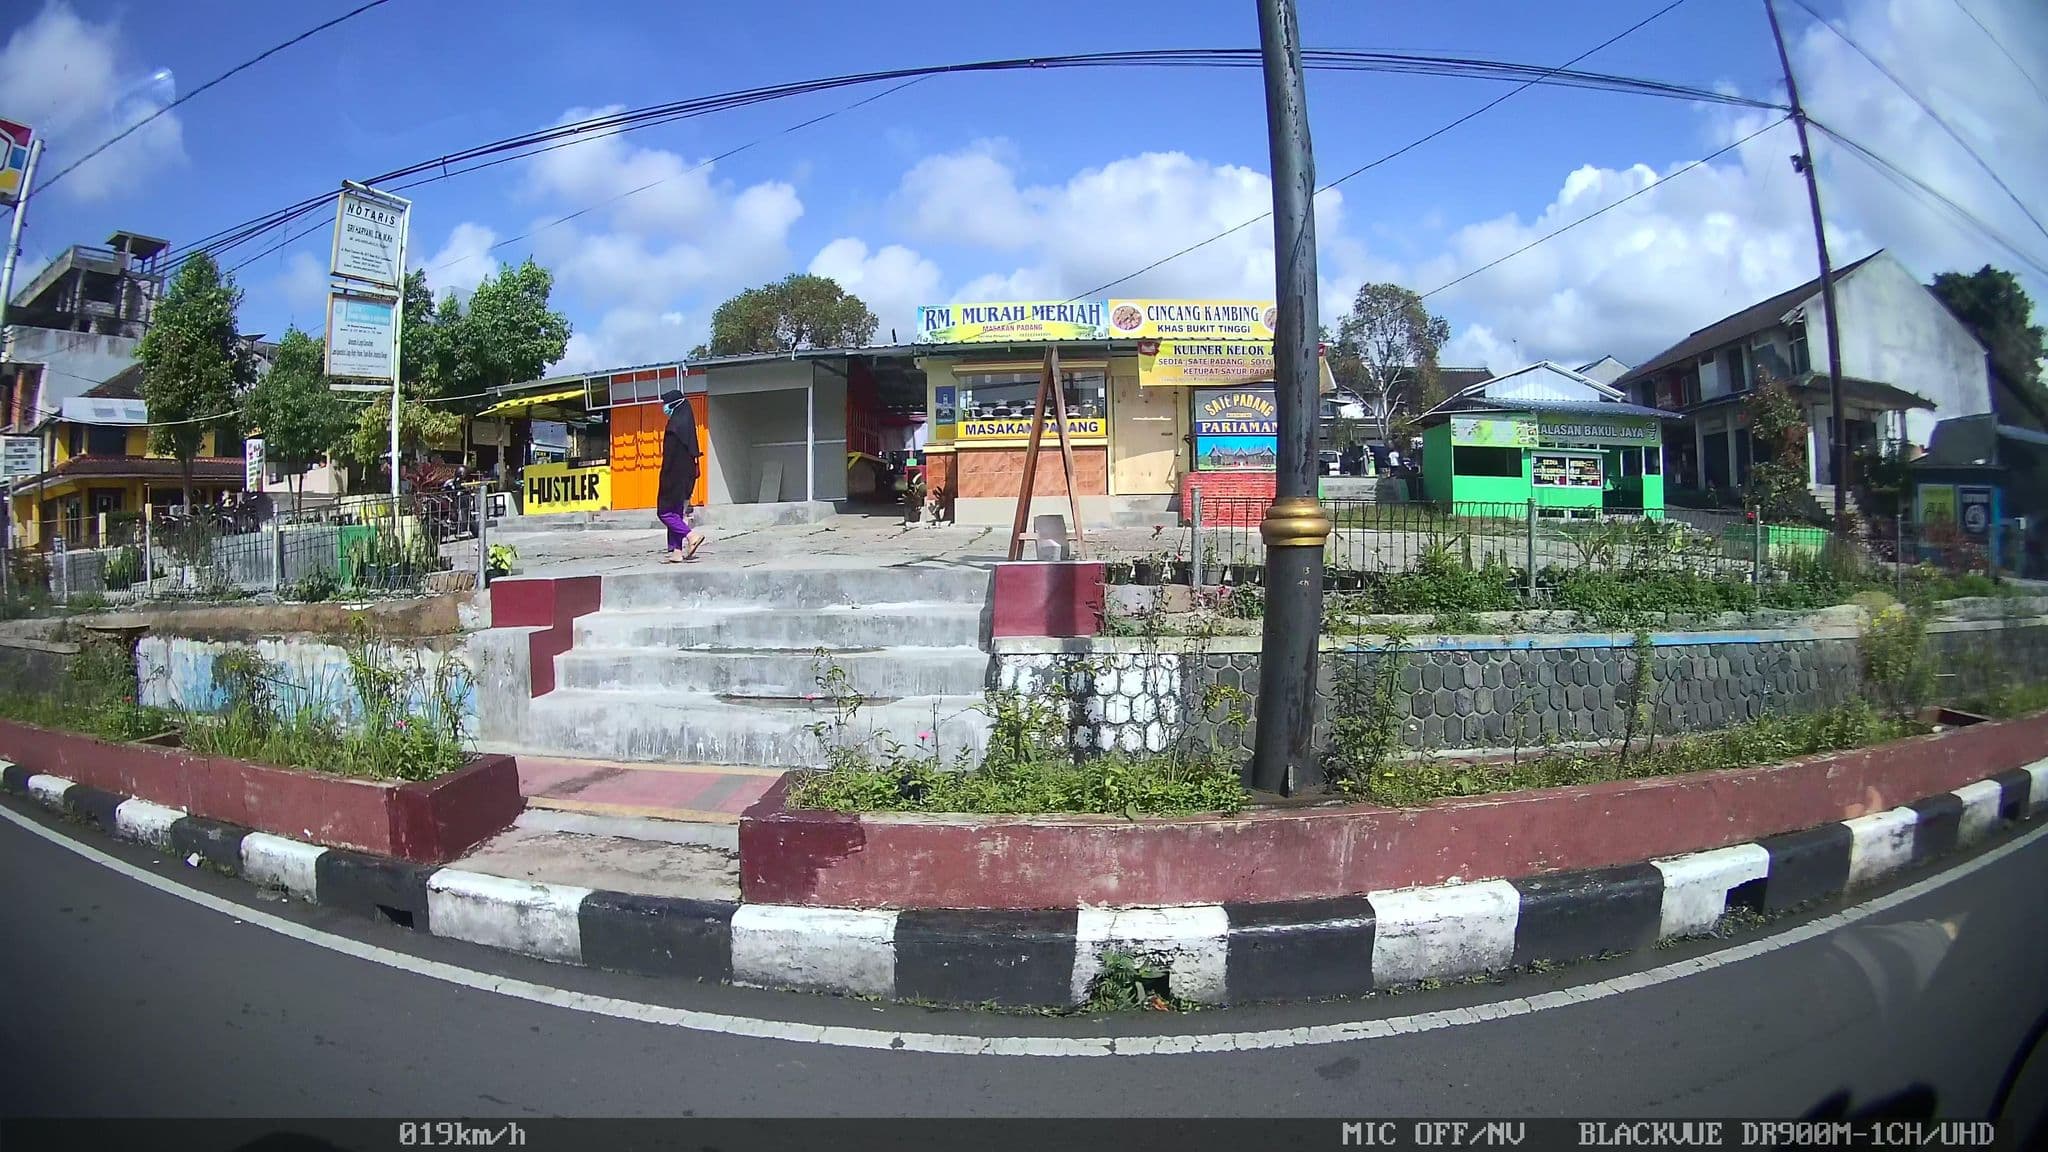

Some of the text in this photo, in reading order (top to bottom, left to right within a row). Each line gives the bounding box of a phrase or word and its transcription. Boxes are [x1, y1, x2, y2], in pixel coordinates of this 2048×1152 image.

[347, 202, 395, 225] NOTARIS
[925, 304, 1100, 331] RM. MURAH MERIAH
[1147, 305, 1259, 322] CINCANG KAMBING
[982, 325, 1015, 333] MASAKAN
[1157, 324, 1251, 334] KHAS BUKIT TINGGI
[1174, 345, 1222, 355] KULINER
[1227, 345, 1264, 355] KELOK
[1250, 358, 1272, 366] SOTO
[1204, 393, 1274, 417] SATE PADANG
[965, 421, 1098, 435] MASAKAN PAANG
[1538, 424, 1644, 438] ALASAN BAKUL JAYA
[528, 473, 600, 505] HUSTLER
